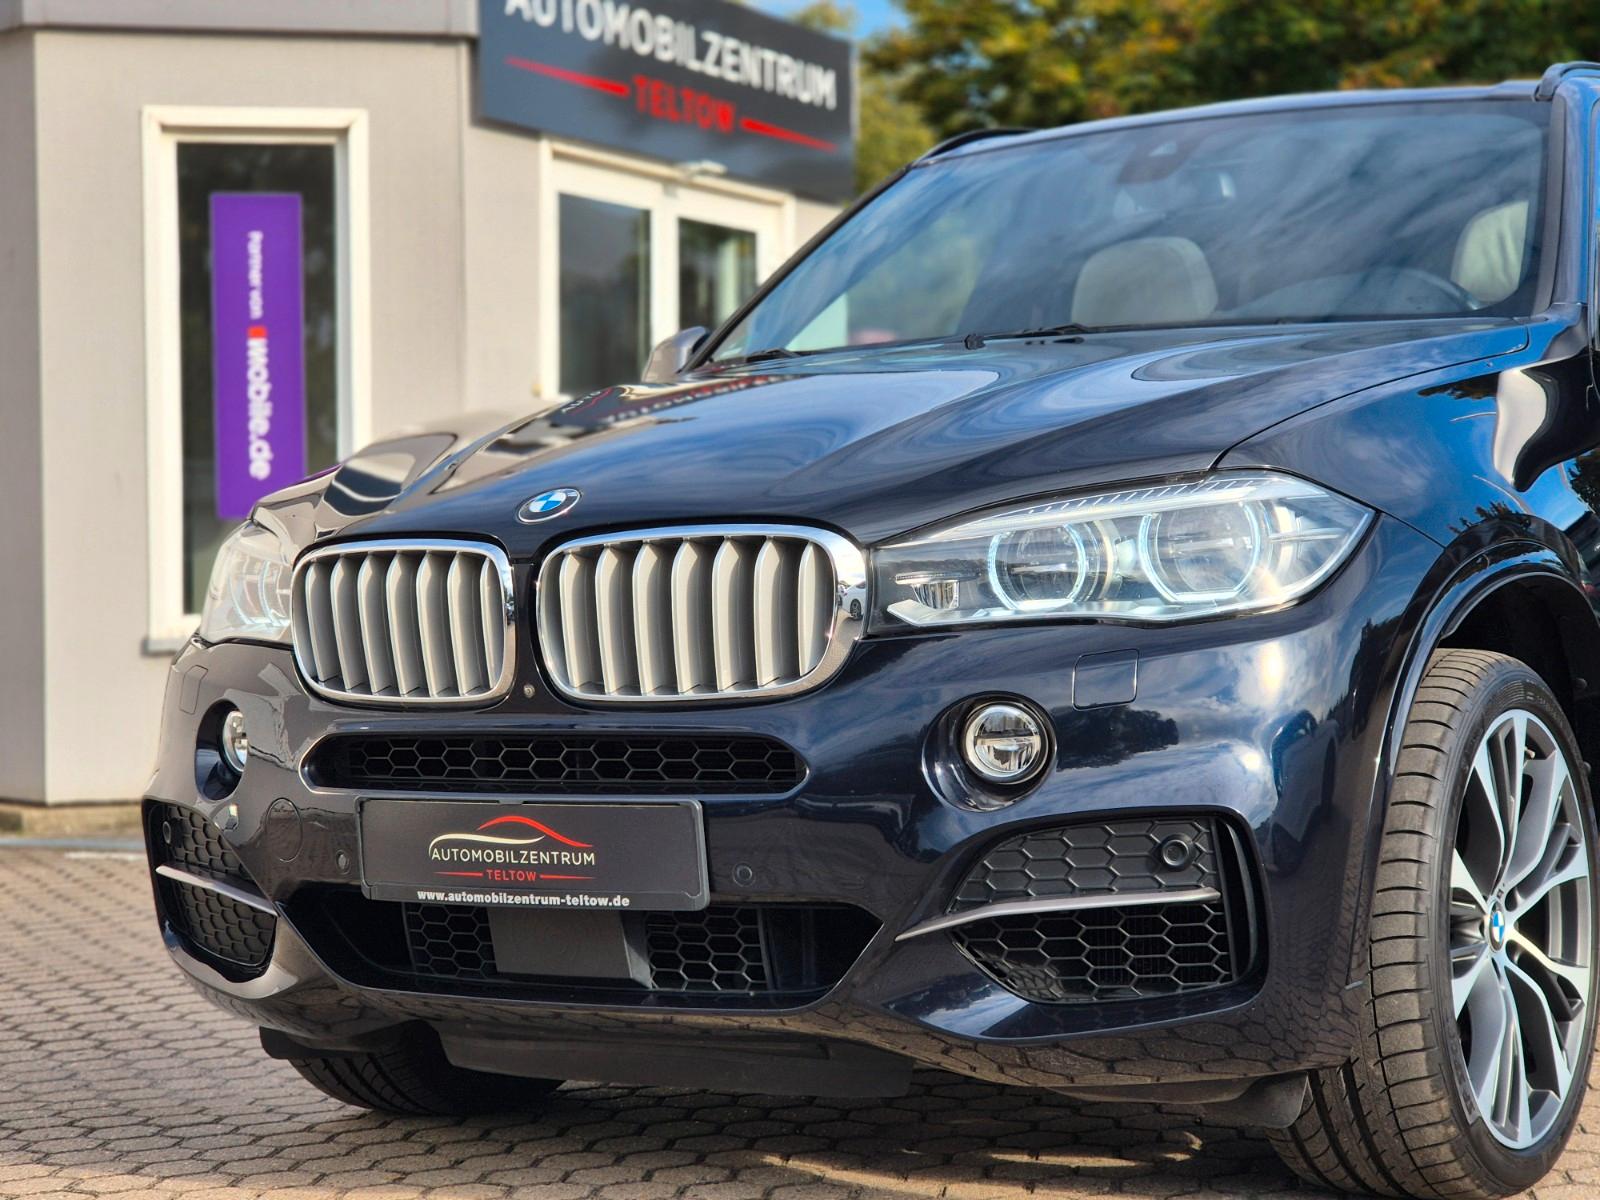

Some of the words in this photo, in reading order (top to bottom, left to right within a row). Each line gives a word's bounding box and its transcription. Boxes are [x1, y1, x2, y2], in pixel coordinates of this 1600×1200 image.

[632, 74, 735, 133] TELTOW
[247, 338, 273, 480] mobile.de
[430, 848, 596, 866] AUTOMOBILZENTRUM
[486, 869, 537, 882] TELTOW
[416, 890, 630, 907] www.automobilzentrum-teltow.de
